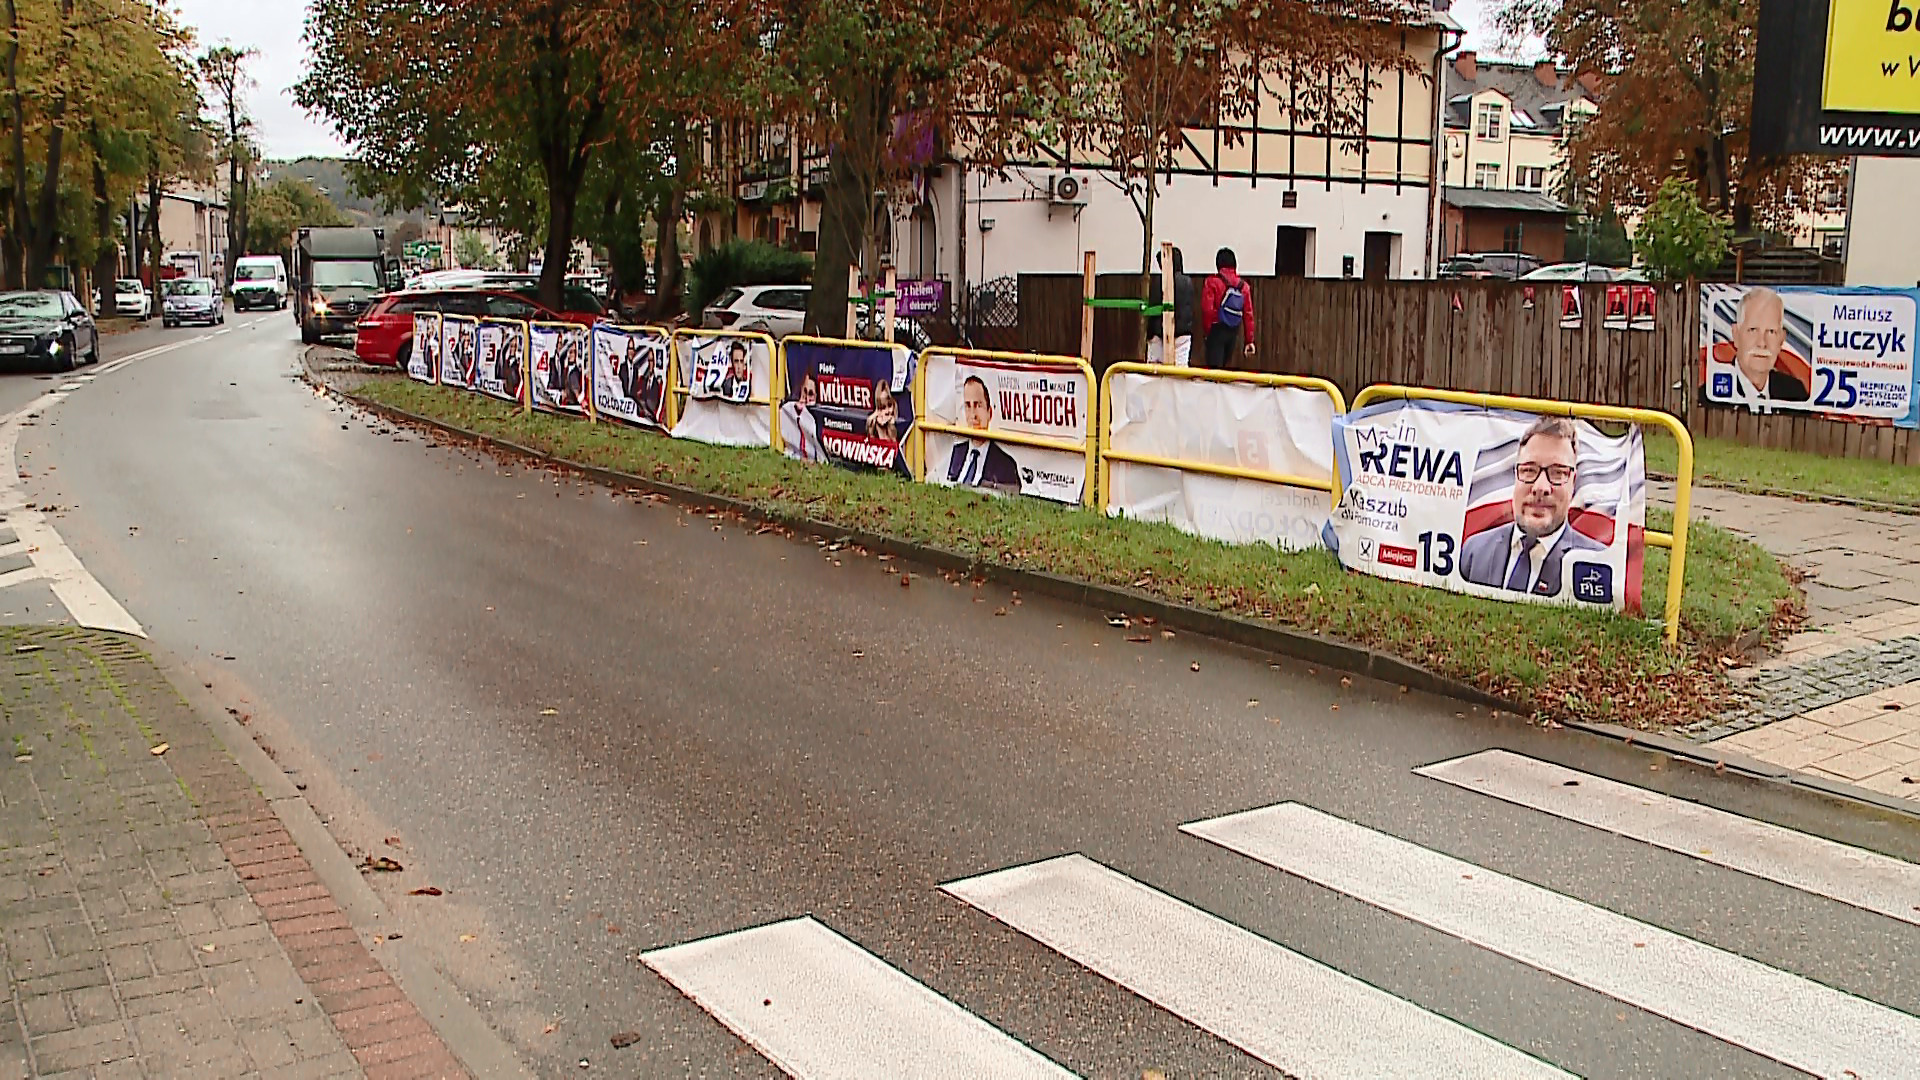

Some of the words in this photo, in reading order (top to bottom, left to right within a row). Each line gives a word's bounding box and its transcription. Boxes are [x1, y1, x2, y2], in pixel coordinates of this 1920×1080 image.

[1833, 305, 1893, 322] Mariusz
[1818, 323, 1906, 358] Łuczyk
[818, 362, 836, 374] Piotr
[1872, 361, 1908, 371] Pomorski
[819, 376, 872, 408] MÜLLER
[1814, 367, 1858, 410] 25
[999, 391, 1077, 428] WAŁDOCH
[823, 436, 896, 469] NOWIŃSKA
[1349, 489, 1408, 518] Kaszub
[1389, 479, 1447, 496] PREZYDENTA
[1449, 489, 1463, 500] RP
[1418, 530, 1455, 577] 13
